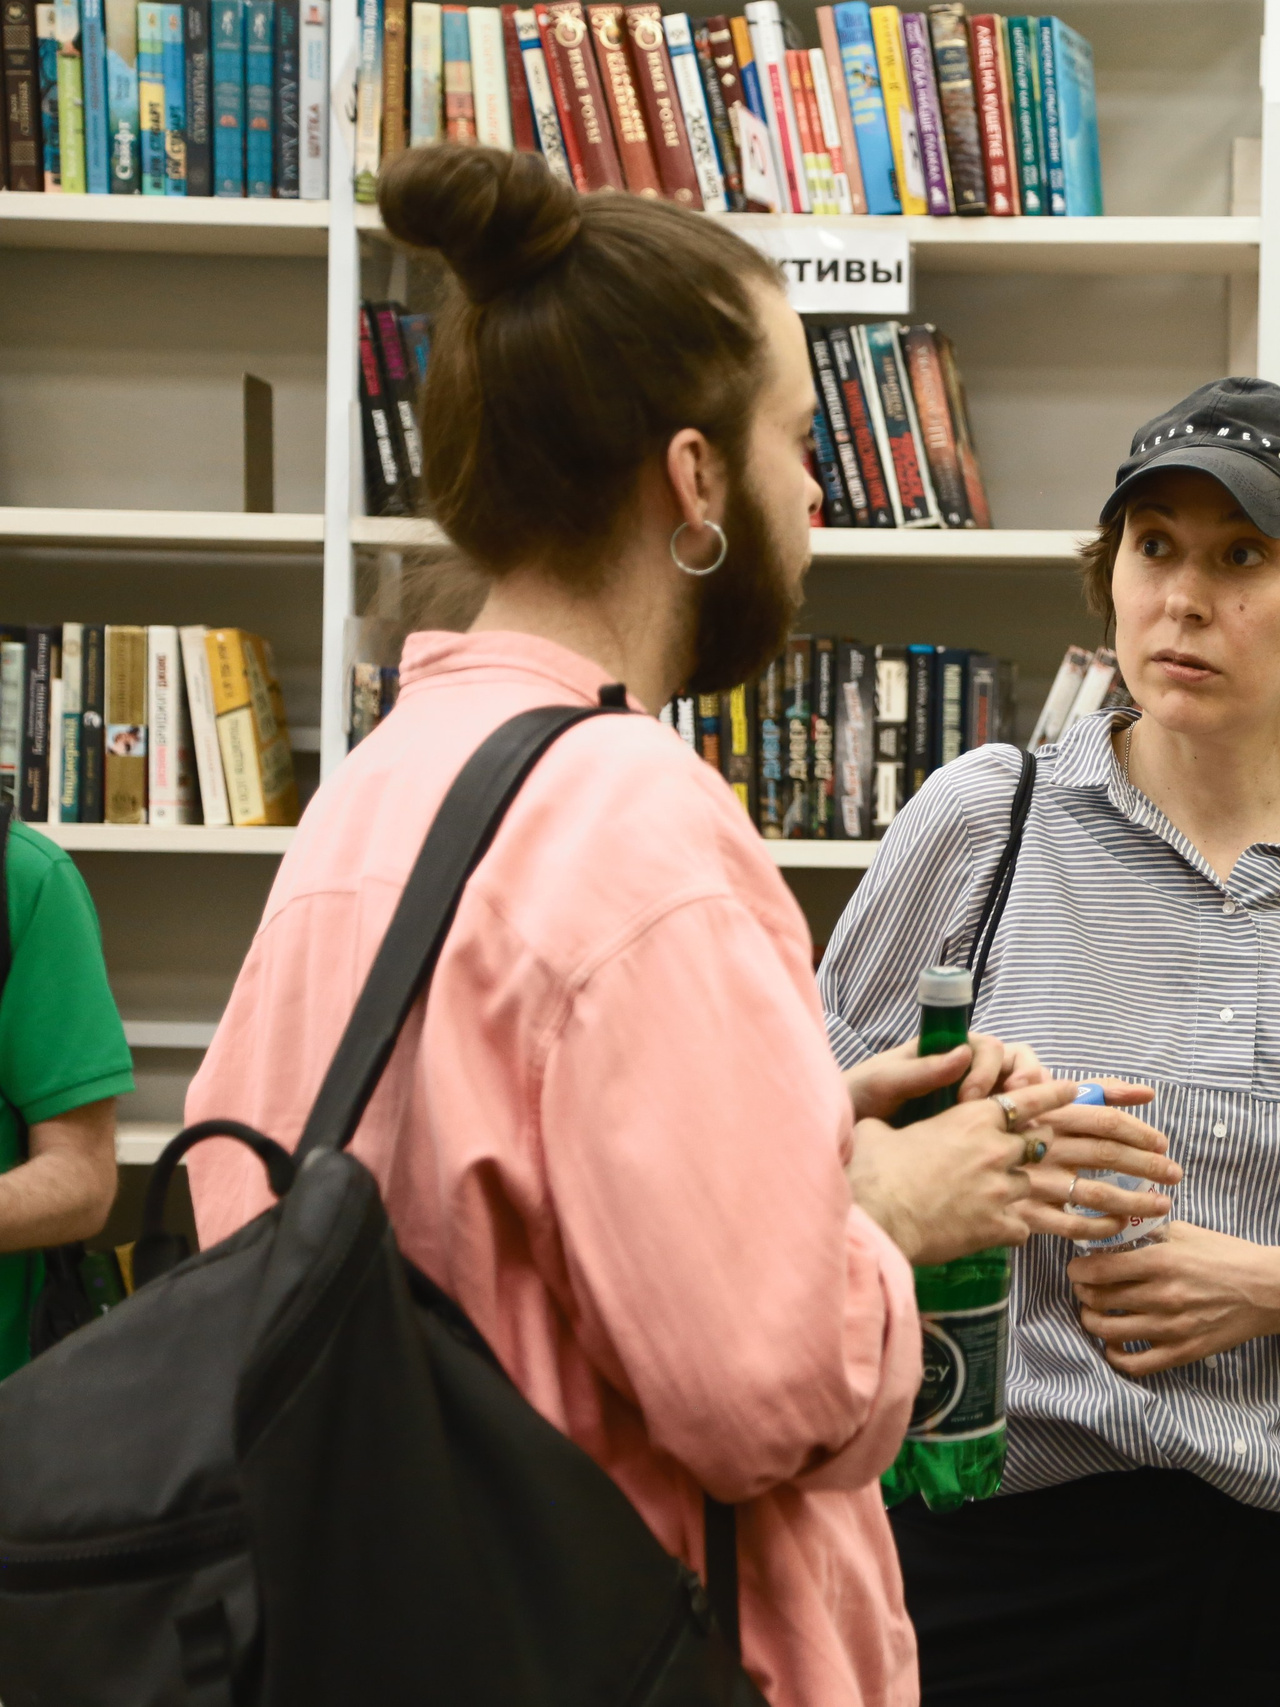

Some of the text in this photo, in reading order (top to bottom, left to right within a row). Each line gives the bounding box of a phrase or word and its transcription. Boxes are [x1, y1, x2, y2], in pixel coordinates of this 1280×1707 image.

[910, 47, 927, 89] КОГДА
[976, 25, 995, 70] ЛЖЕЦ
[567, 48, 603, 145] ИМЯ РОЗЫ
[646, 51, 680, 148] ИМЯ РОЗЫ
[982, 93, 1004, 158] КУШЕТКЕ
[779, 259, 903, 283] ТИВЫ
[1140, 424, 1194, 452] LESS
